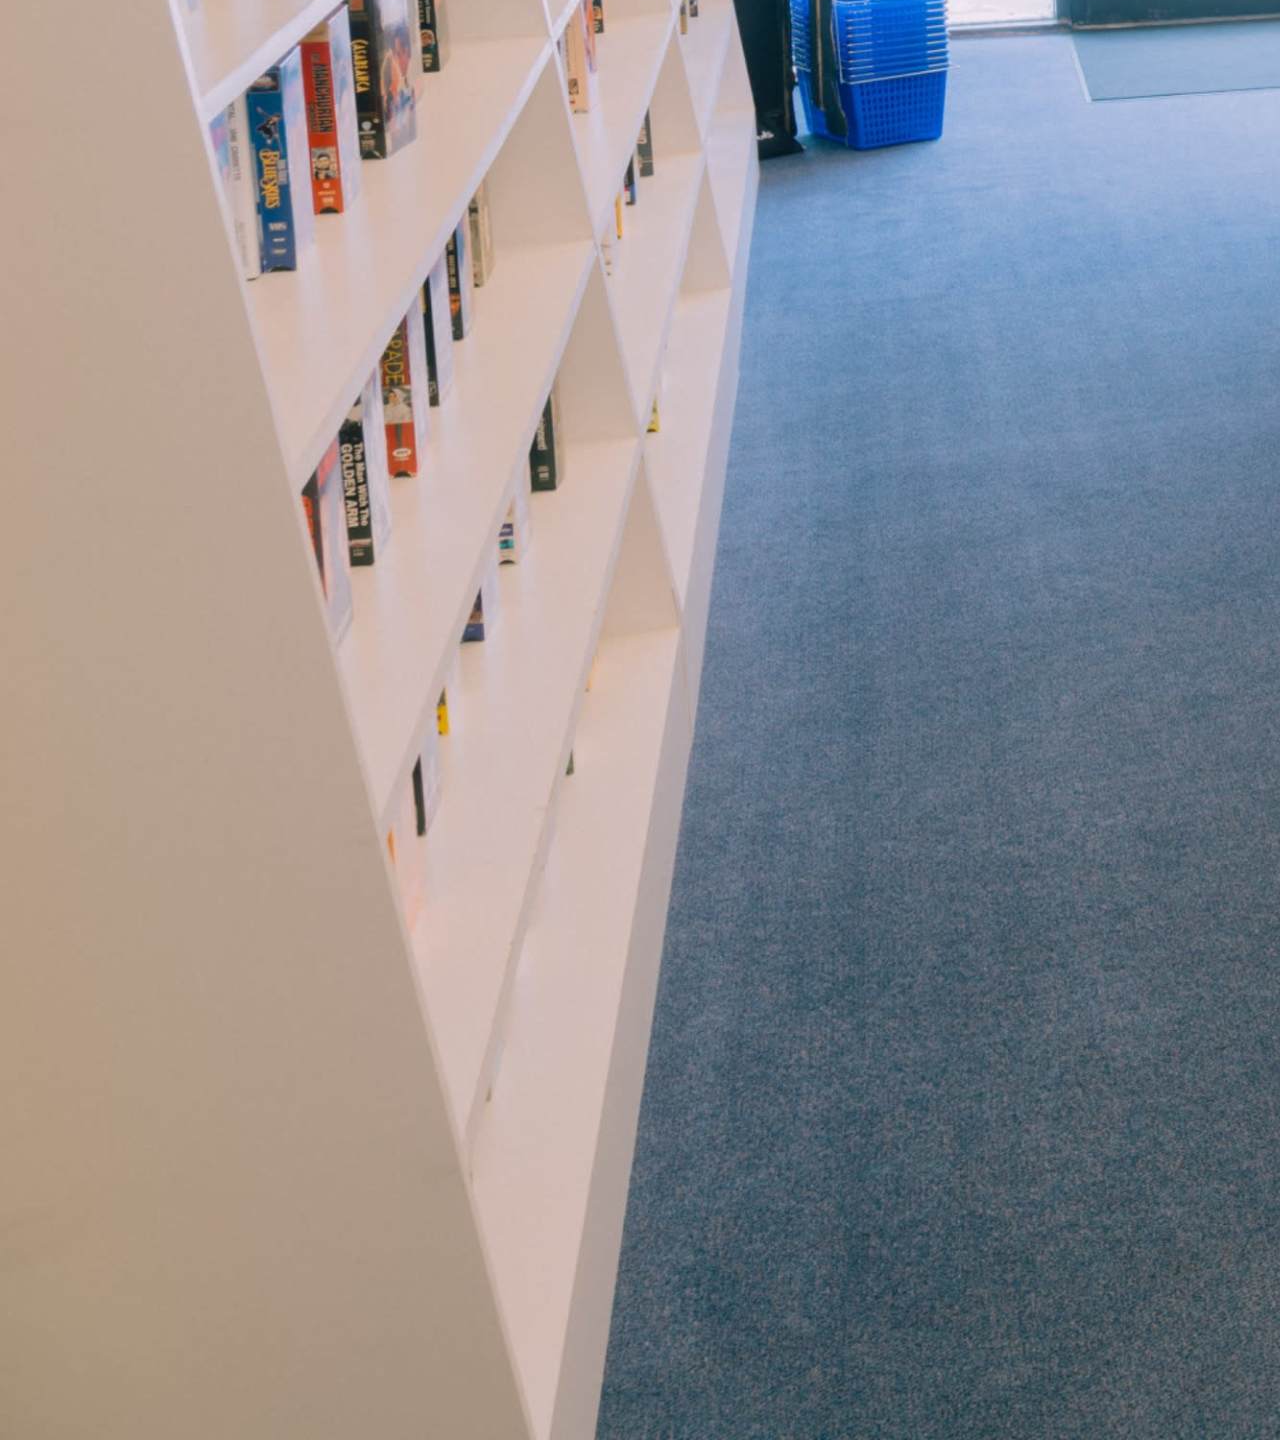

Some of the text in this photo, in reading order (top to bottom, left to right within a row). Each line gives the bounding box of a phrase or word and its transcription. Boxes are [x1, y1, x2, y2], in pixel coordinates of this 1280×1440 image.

[350, 39, 369, 93] CASABLANCA
[340, 443, 359, 527] GOLDEN ARM
[353, 442, 369, 526] The Man With The
